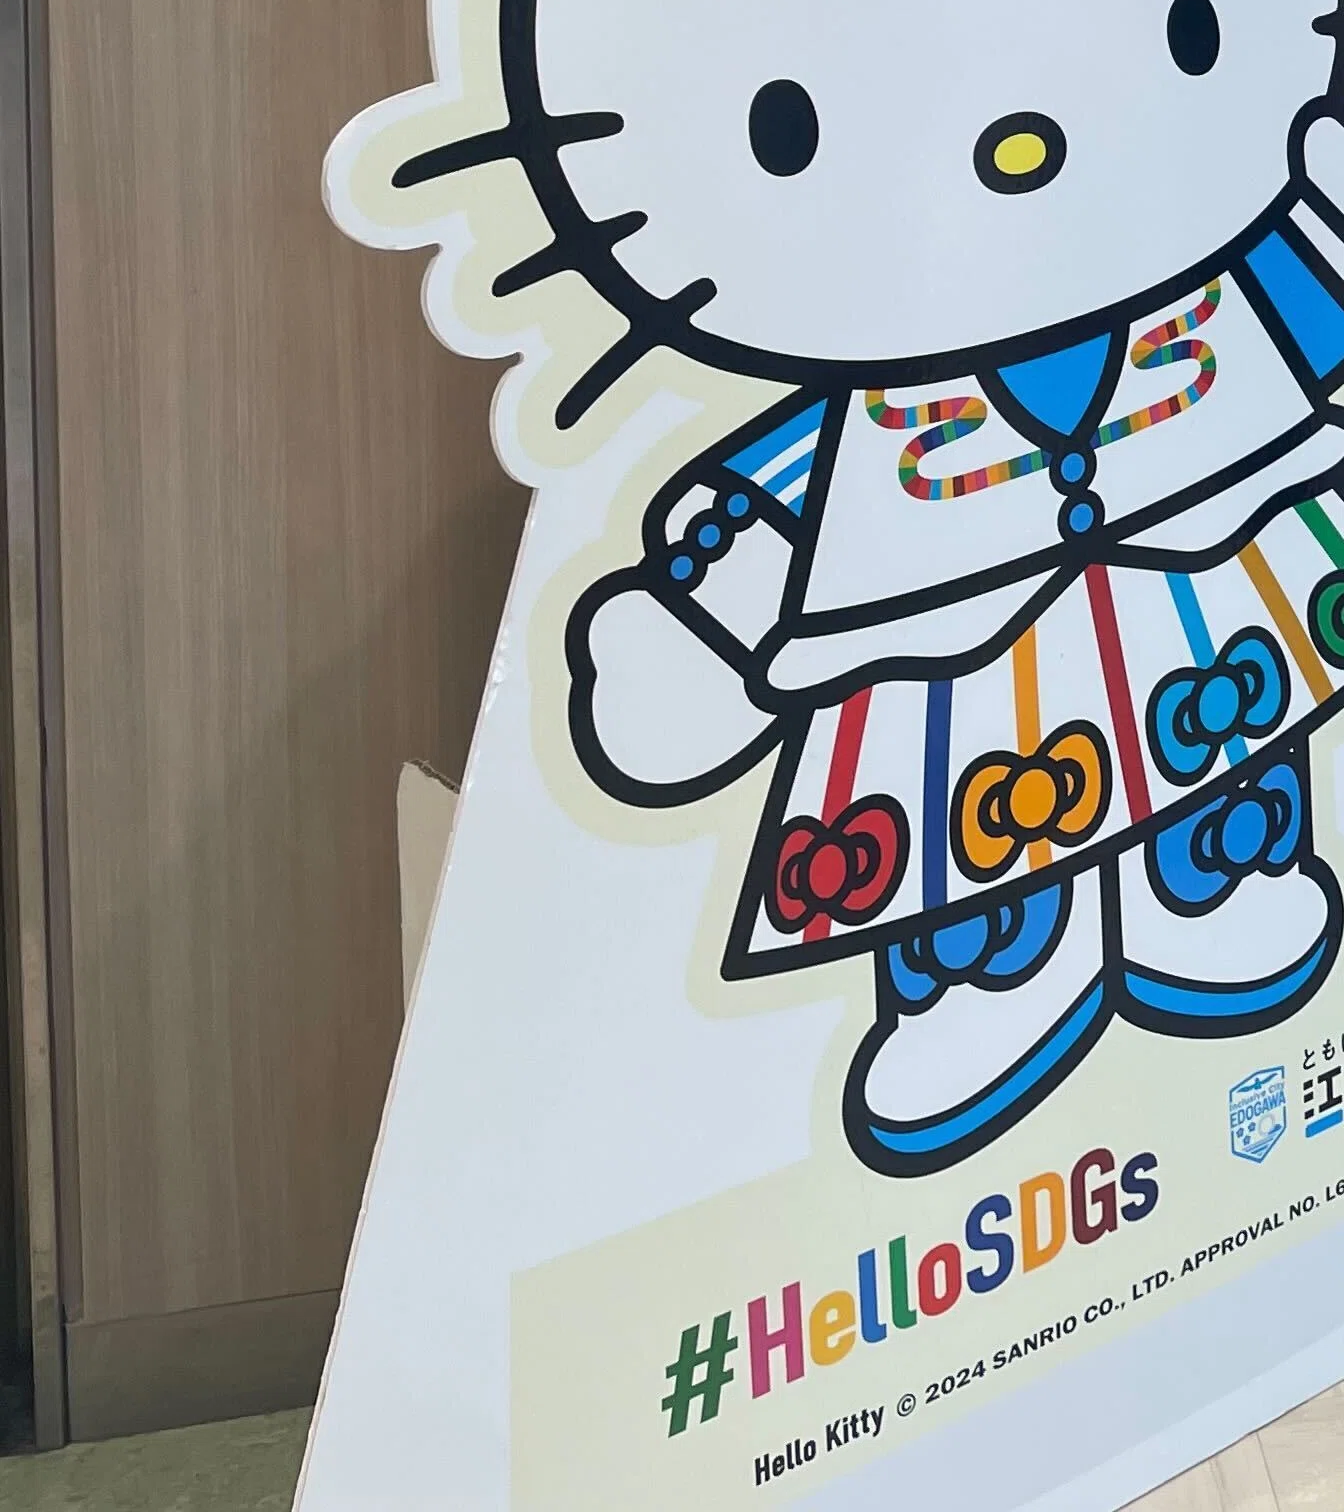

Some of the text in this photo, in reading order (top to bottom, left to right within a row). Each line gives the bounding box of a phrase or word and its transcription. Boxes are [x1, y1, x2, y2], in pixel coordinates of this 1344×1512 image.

[1230, 1091, 1287, 1129] EDOGAWA
[660, 1147, 1161, 1439] #HelloSDGs
[754, 1437, 818, 1486] Hello
[824, 1405, 886, 1453] Kitty
[924, 1359, 988, 1406] 2024
[991, 1314, 1079, 1371] SANRIO
[1082, 1295, 1127, 1325] CO.,
[1130, 1268, 1176, 1302] LTD.
[1180, 1214, 1285, 1277] APPROVAL
[1287, 1188, 1322, 1219] NO.
